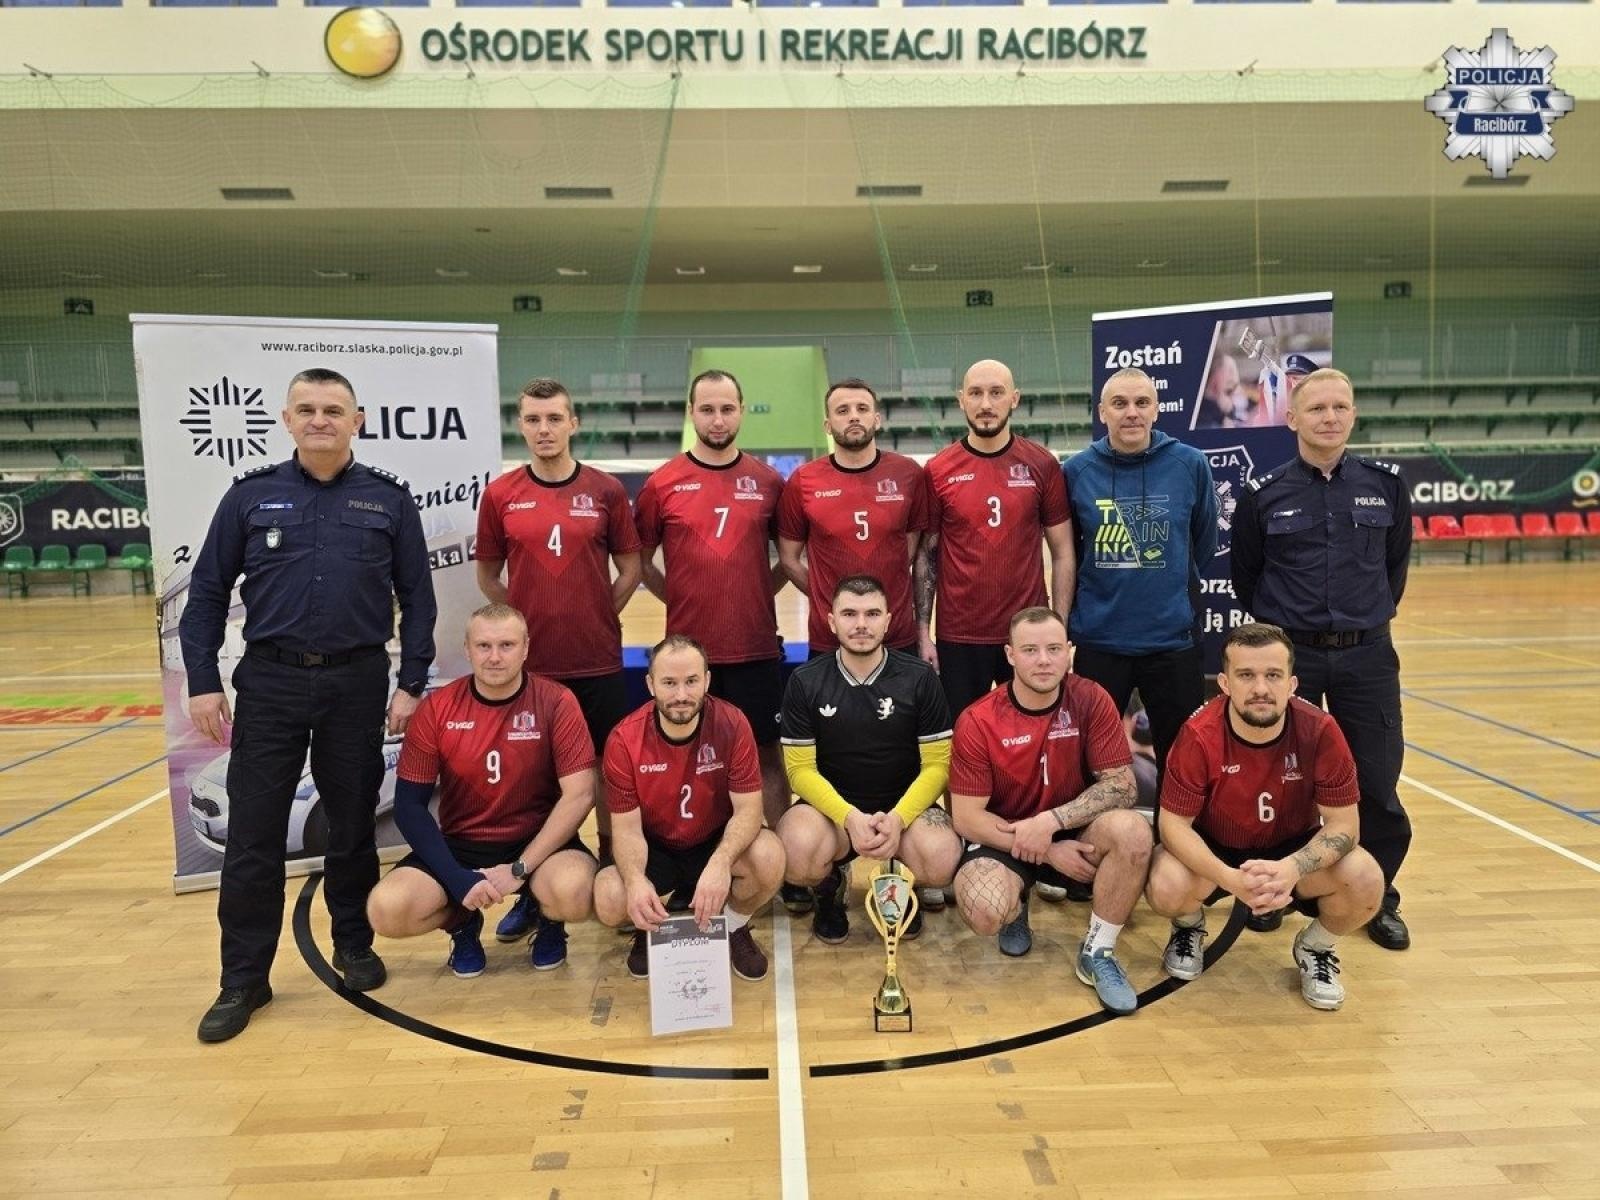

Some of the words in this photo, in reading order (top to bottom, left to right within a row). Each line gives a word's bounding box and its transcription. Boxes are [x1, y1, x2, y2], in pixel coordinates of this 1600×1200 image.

[421, 22, 591, 62] OŚRODEK
[605, 29, 744, 62] SPORTU
[759, 30, 766, 61] I
[780, 29, 963, 61] REKREACJI
[978, 21, 1148, 60] RACIBÓRZ
[261, 341, 464, 357] www.raciborz.slaska.policja.gov.pl
[1104, 340, 1183, 369] Zostań
[1354, 496, 1386, 507] POLICJA
[1410, 474, 1515, 503] CIBÓRZ
[348, 500, 385, 513] POLICJA
[986, 496, 1001, 528] 3
[713, 507, 730, 538] 7
[853, 510, 869, 541] 5
[547, 523, 562, 557] 4
[1203, 607, 1224, 633] ją
[486, 749, 501, 785] 9
[1040, 752, 1049, 785] 1
[680, 784, 694, 819] 2
[1258, 791, 1275, 823] 6
[671, 937, 710, 949] DYPLOM
